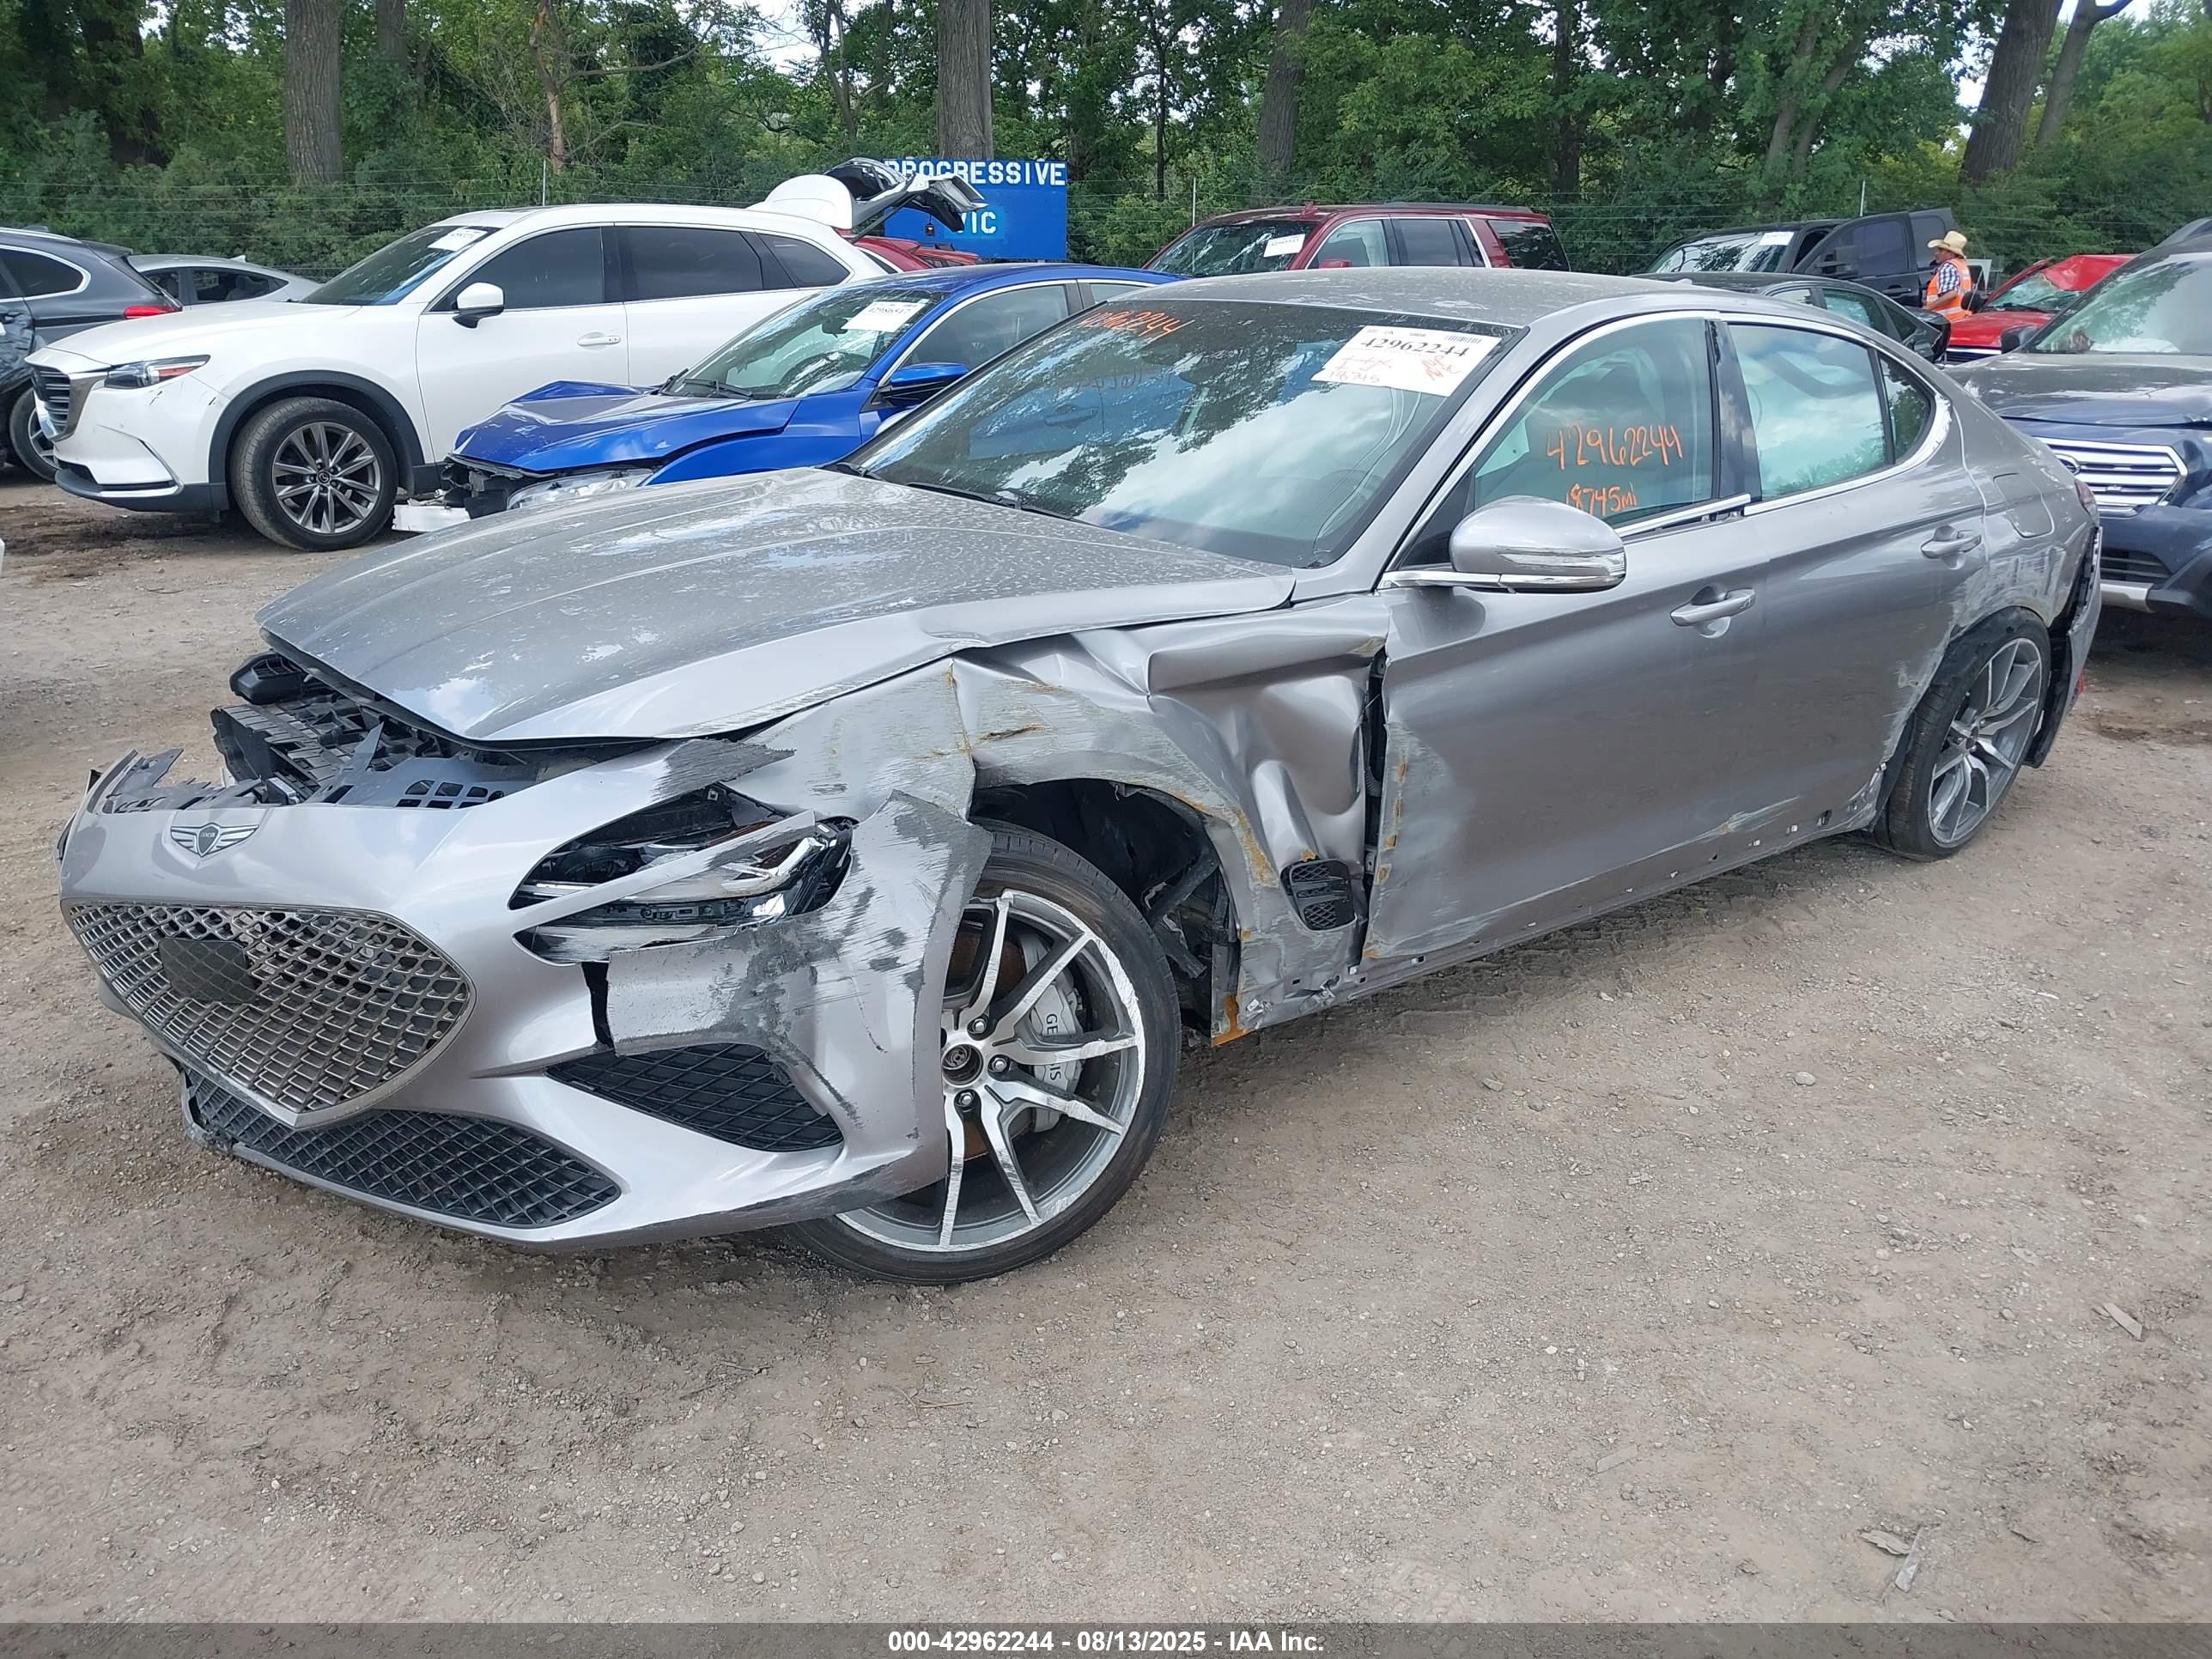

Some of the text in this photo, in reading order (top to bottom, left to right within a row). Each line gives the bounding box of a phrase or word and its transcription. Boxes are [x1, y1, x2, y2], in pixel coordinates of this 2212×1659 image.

[884, 160, 1066, 185] PROGRESSIVE
[1360, 337, 1470, 357] 42962244
[1547, 425, 1683, 471] 42962244
